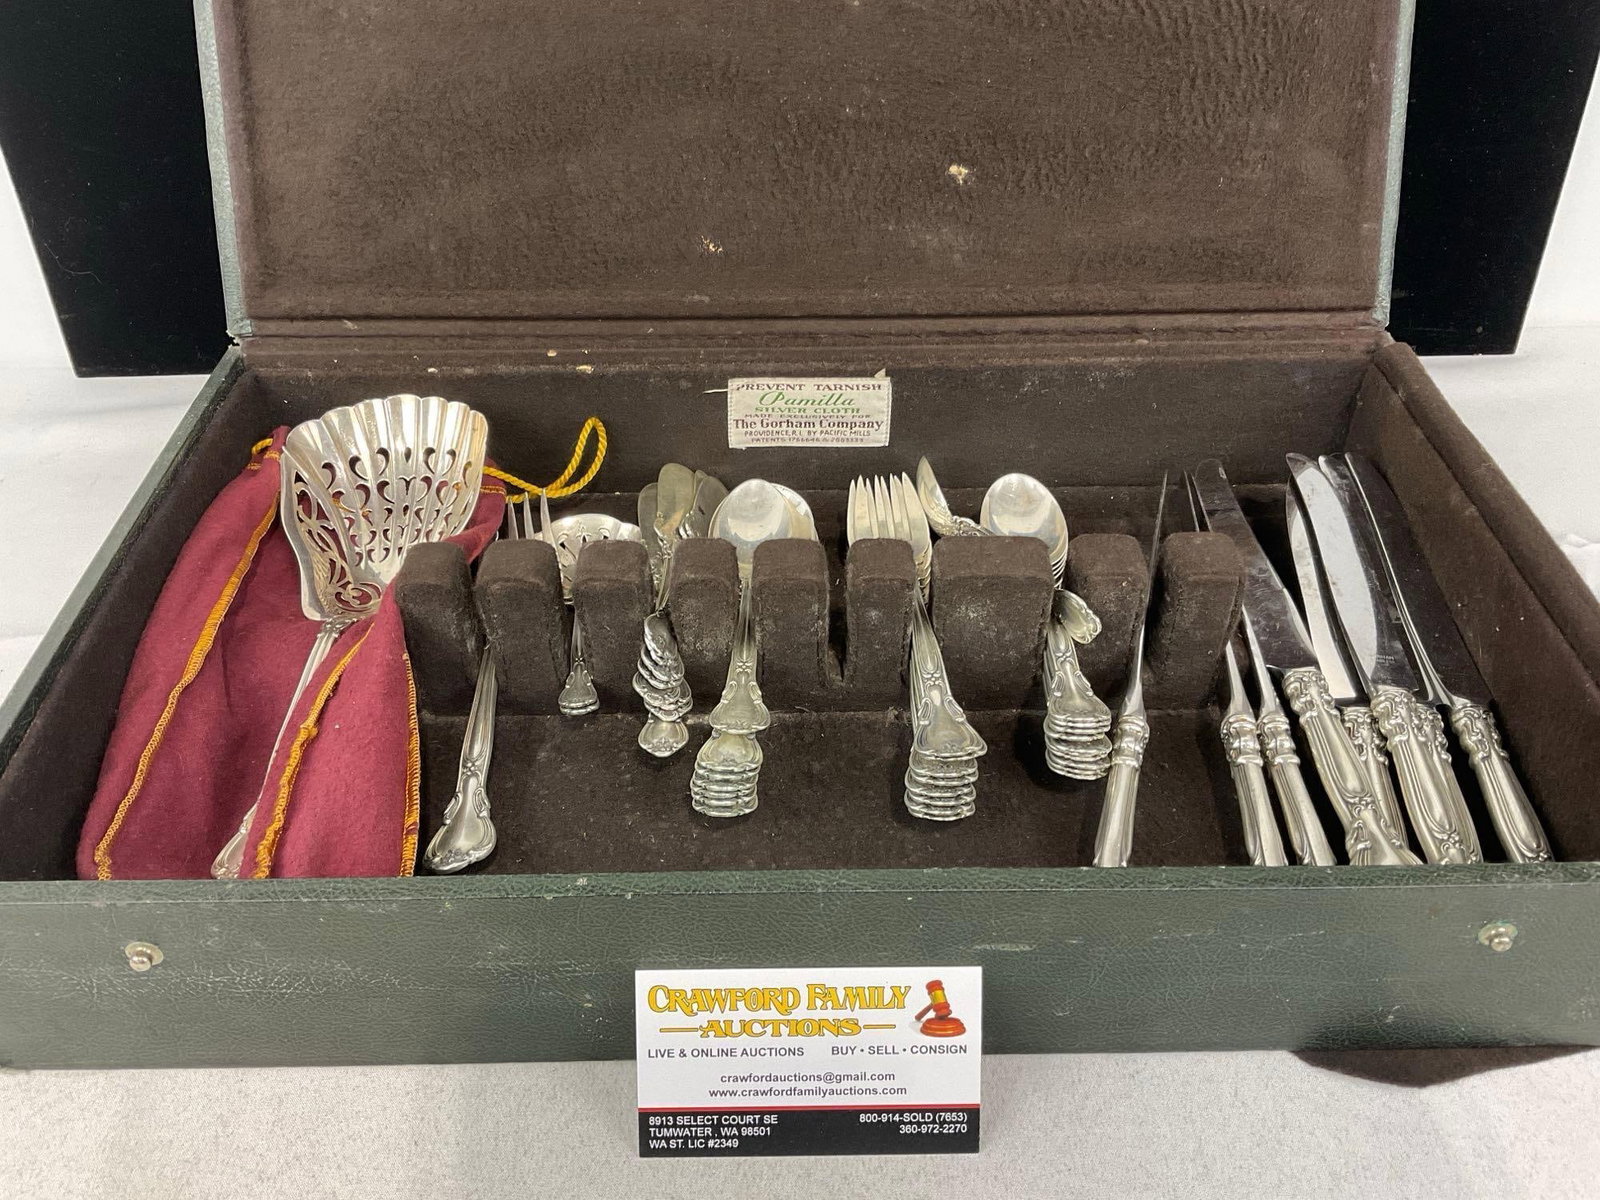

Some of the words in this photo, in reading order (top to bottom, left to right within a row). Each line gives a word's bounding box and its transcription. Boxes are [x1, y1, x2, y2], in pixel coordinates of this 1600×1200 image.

[814, 383, 882, 391] TARNISH
[759, 391, 856, 407] Pamilla
[733, 418, 757, 429] The
[760, 418, 816, 429] Gorham
[819, 418, 884, 432] Company
[648, 984, 801, 1016] CRAWFORD
[807, 984, 911, 1011] FAMILY
[699, 1018, 862, 1038] AUCTIONS
[648, 1049, 676, 1058] LIVE
[678, 1048, 688, 1058] &
[690, 1048, 738, 1058] ONLINE
[740, 1047, 804, 1057] AUCTIONS
[831, 1046, 857, 1056] BUY
[868, 1045, 899, 1055] SELL
[910, 1045, 967, 1055] CONSIGN
[720, 1072, 895, 1084] crawfordauctions@gmail.com
[708, 1085, 907, 1098] www.crawfordfamilyauctions.com
[649, 1116, 674, 1125] 8913
[676, 1116, 719, 1125] SELECT
[721, 1115, 762, 1125] COURT
[764, 1115, 778, 1124] SE
[859, 1112, 933, 1123] 800-914-SOLD
[935, 1112, 967, 1123] (7653)
[720, 1127, 740, 1137] WA
[741, 1127, 770, 1136] 98501
[899, 1124, 967, 1134] 360-972-2270
[649, 1139, 668, 1149] WA
[669, 1139, 686, 1148] ST.
[688, 1139, 705, 1148] LIC
[707, 1139, 739, 1148] #2349
